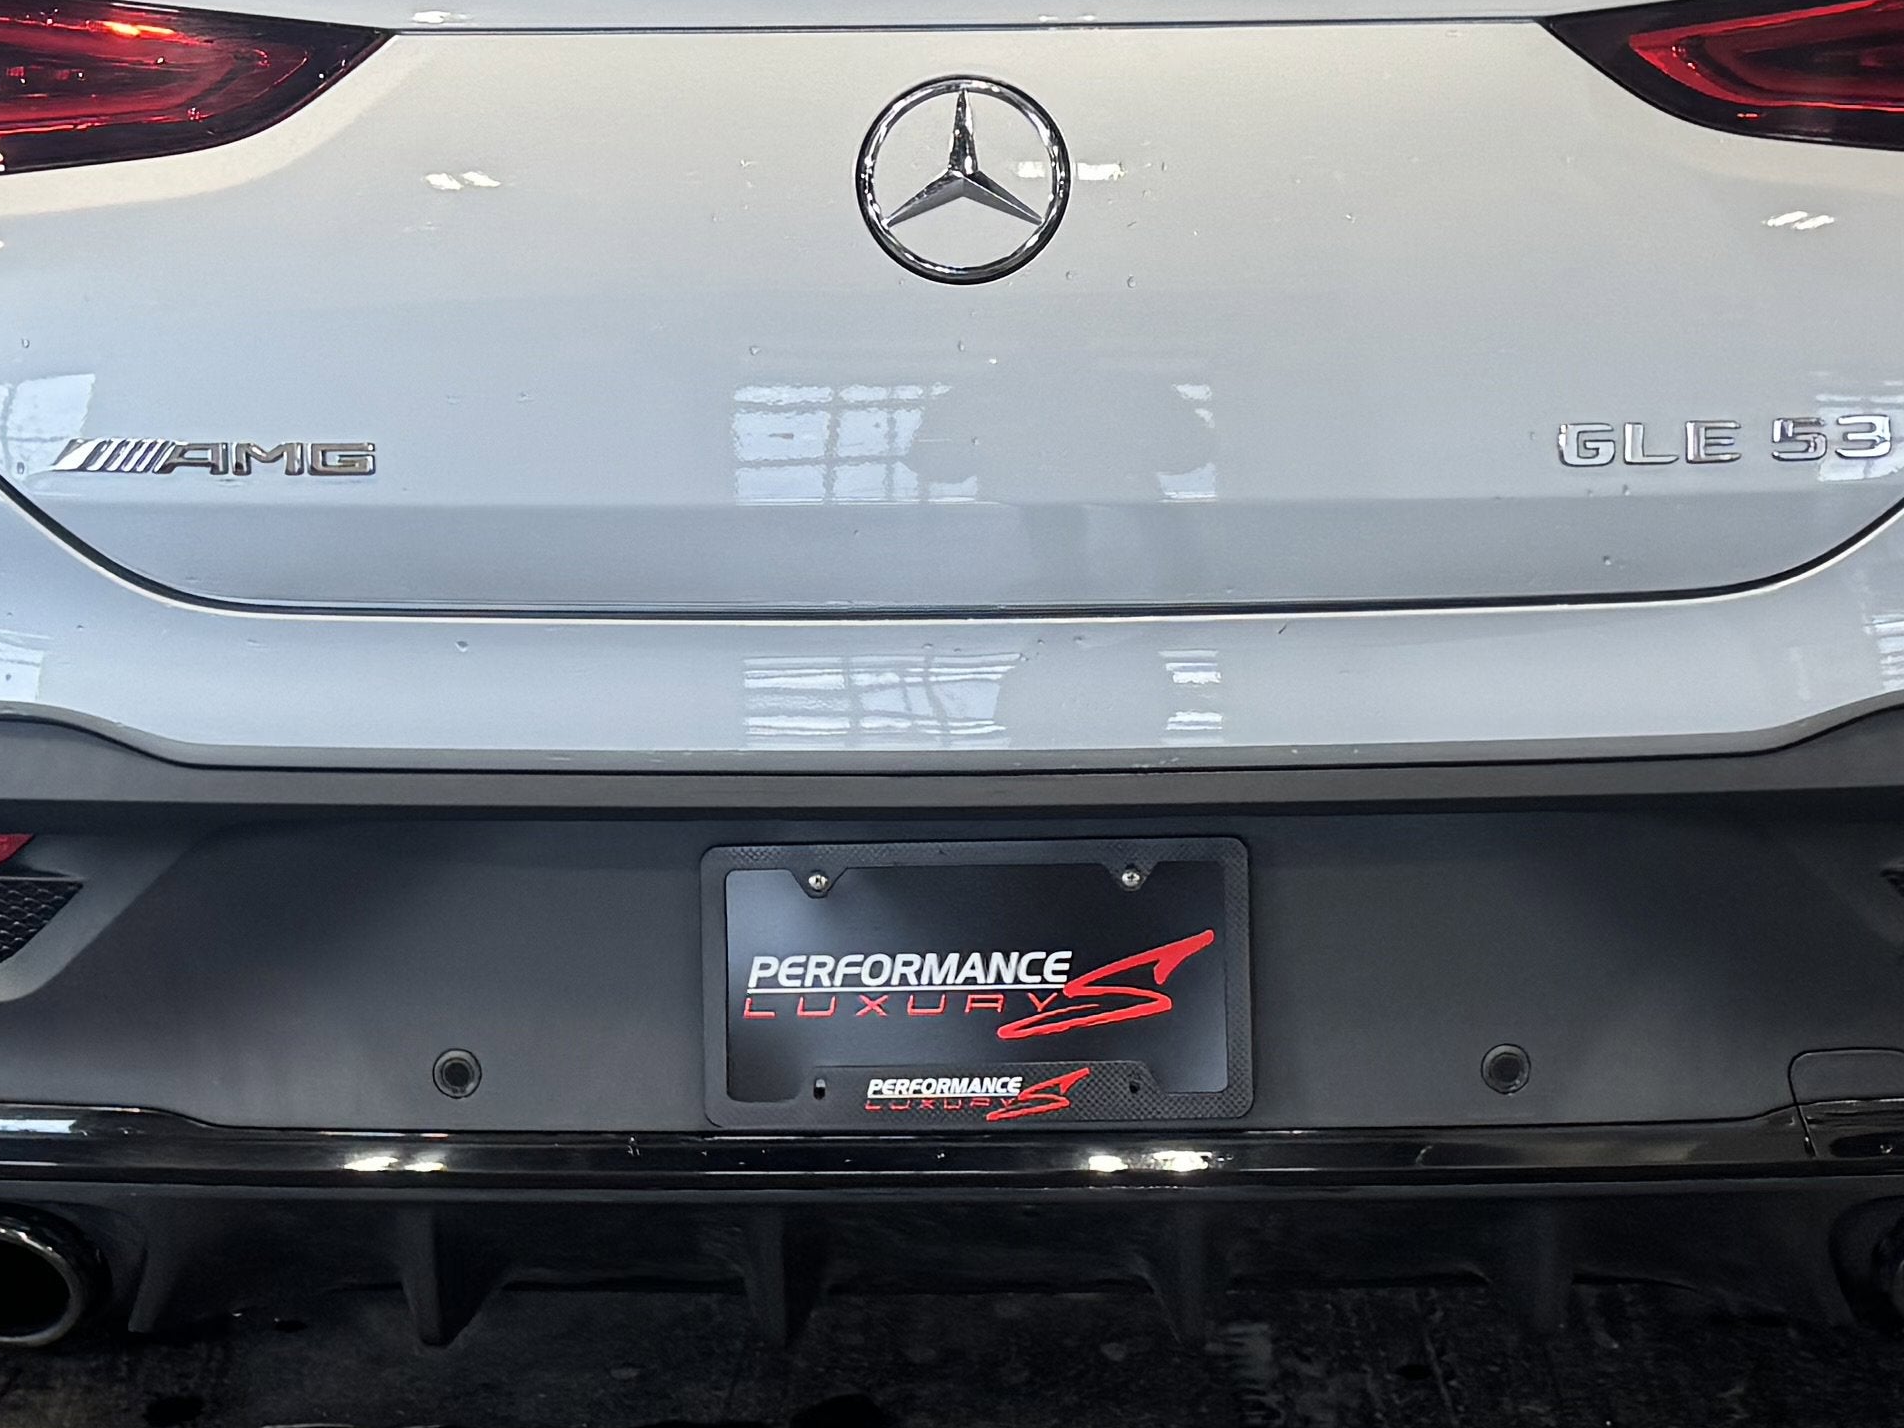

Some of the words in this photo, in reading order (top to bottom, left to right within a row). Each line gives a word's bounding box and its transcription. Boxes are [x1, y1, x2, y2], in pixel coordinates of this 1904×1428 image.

[1558, 420, 1743, 466] GLE
[1772, 413, 1893, 462] 53
[747, 949, 1073, 988] PERFORMANCE
[742, 992, 1059, 1019] LUXURY
[868, 1076, 1023, 1095] PERFORMANCE
[865, 1098, 1016, 1111] LUXURY
